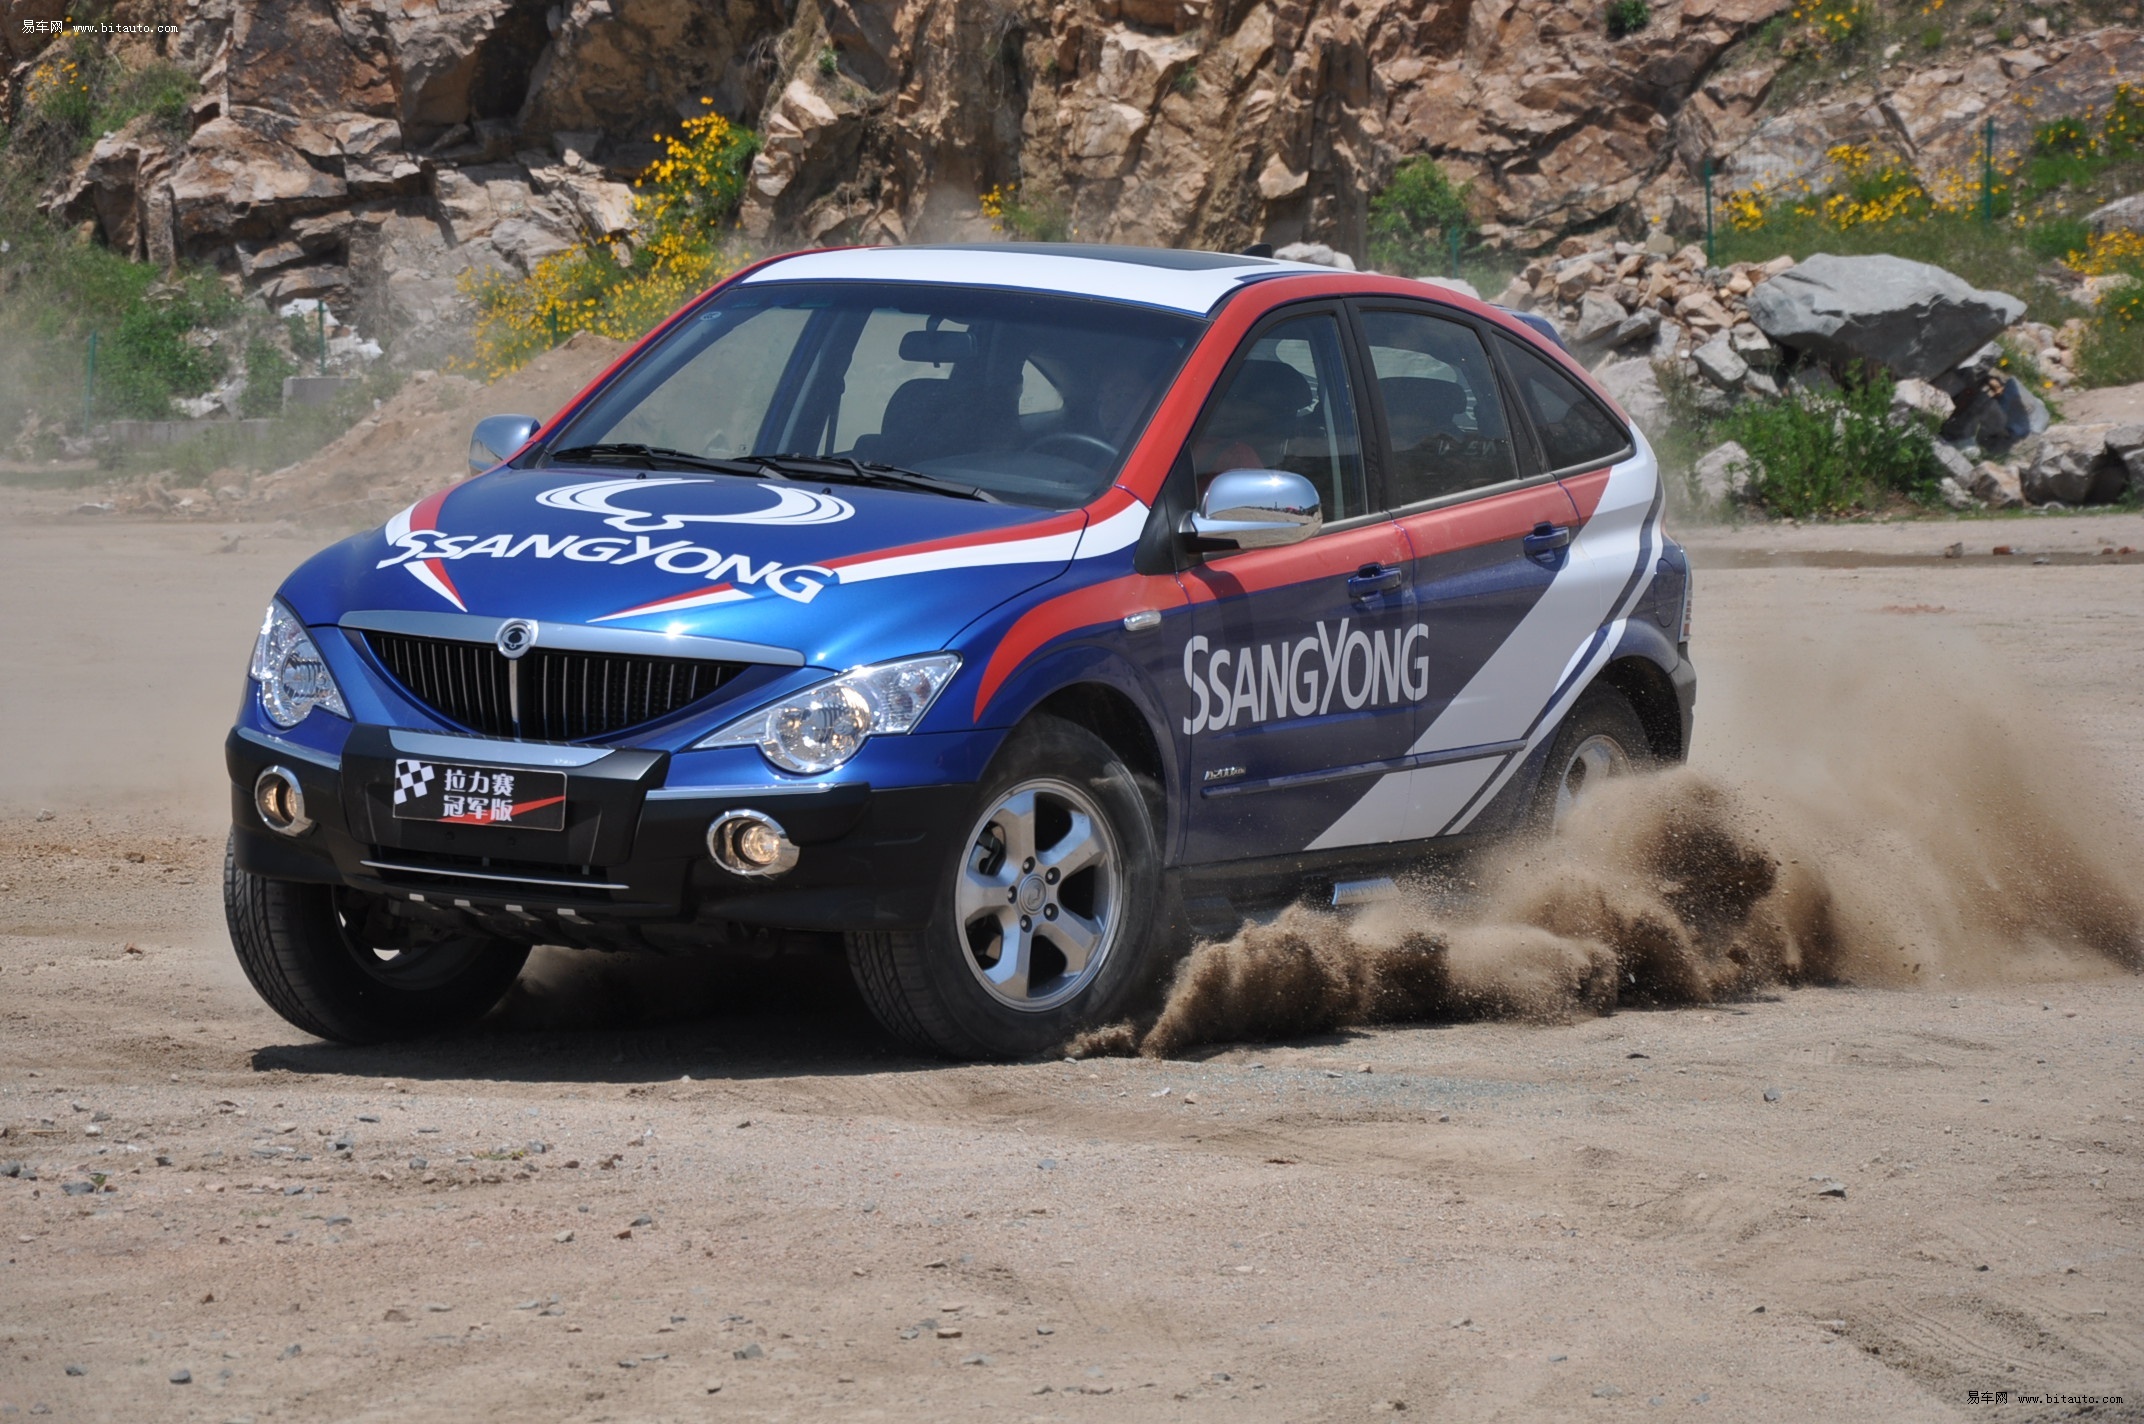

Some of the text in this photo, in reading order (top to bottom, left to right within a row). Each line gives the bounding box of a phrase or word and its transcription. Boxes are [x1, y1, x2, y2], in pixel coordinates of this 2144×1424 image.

[376, 529, 835, 604] SSANGYONG
[1183, 617, 1430, 735] SSANGYONG
[443, 795, 514, 822] 冠军版
[444, 768, 515, 797] 拉力赛
